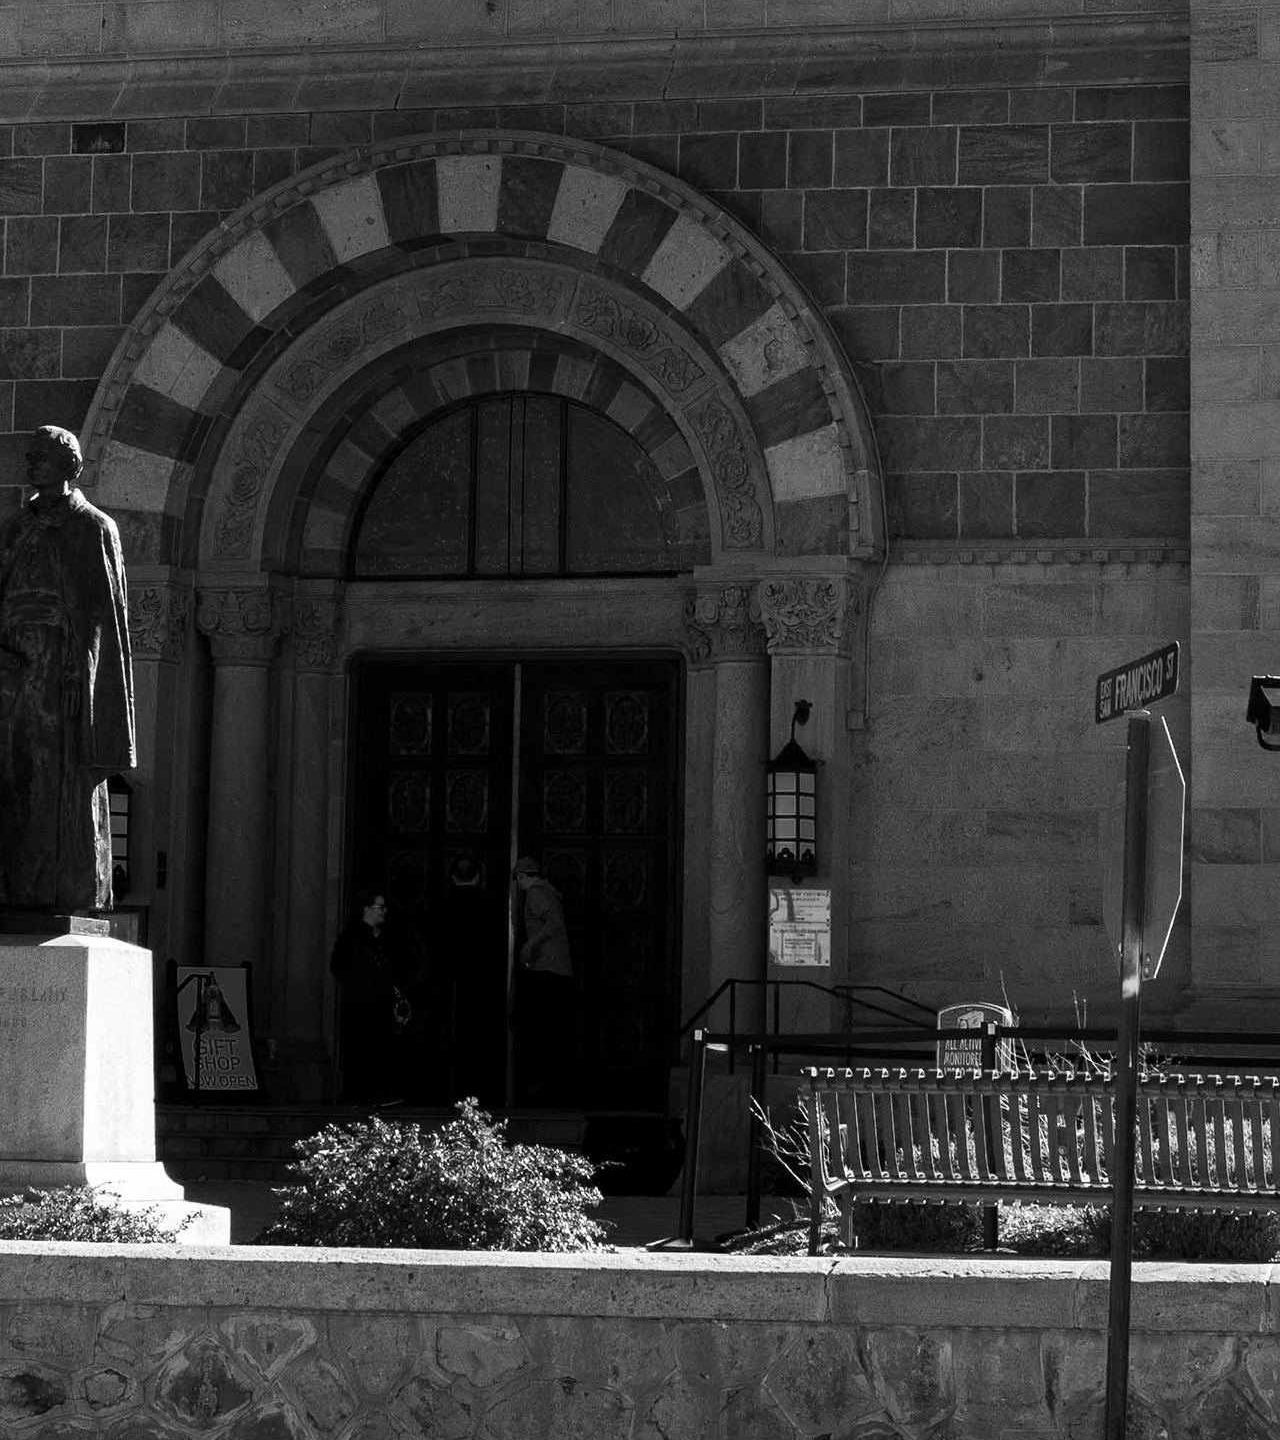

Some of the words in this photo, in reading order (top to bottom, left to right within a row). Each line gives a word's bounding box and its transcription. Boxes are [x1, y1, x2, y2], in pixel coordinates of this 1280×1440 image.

[1101, 678, 1112, 699] EAST
[1115, 657, 1163, 711] FRANCISCO
[1166, 651, 1175, 680] ST
[1100, 698, 1111, 719] SAN
[194, 1039, 236, 1055] GIFT
[945, 1039, 958, 1050] ALL
[195, 1056, 240, 1070] SHOP
[186, 1075, 216, 1087] NOW
[219, 1075, 256, 1087] OPEN
